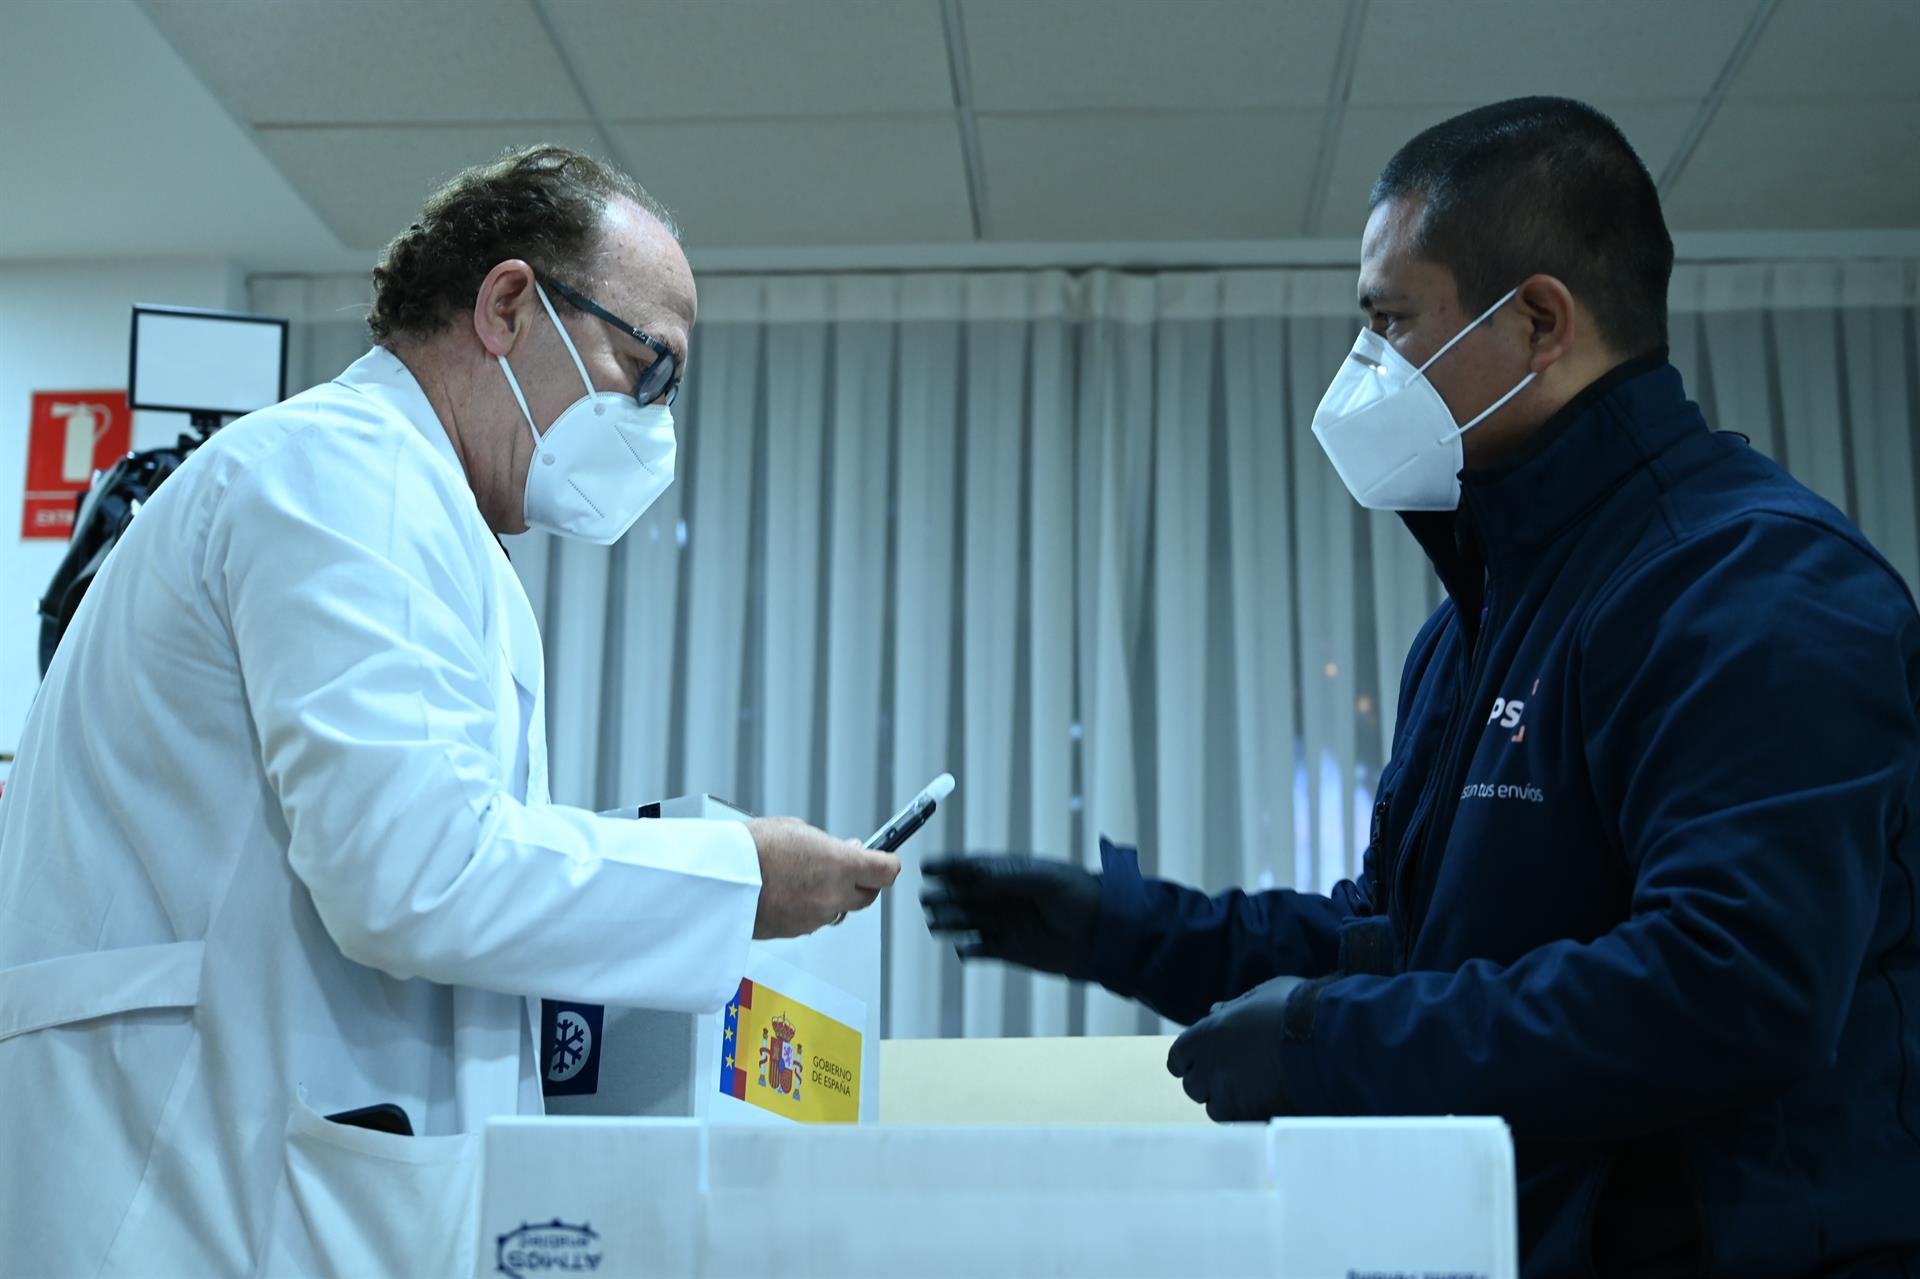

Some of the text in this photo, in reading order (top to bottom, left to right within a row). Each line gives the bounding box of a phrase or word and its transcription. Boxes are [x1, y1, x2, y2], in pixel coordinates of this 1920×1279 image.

[1478, 782, 1495, 797] tus
[1497, 783, 1543, 802] envíos
[812, 1055, 852, 1083] GOBIERNO
[812, 1070, 851, 1097] DE ESPAÑA
[508, 1250, 603, 1272] ATMOS
